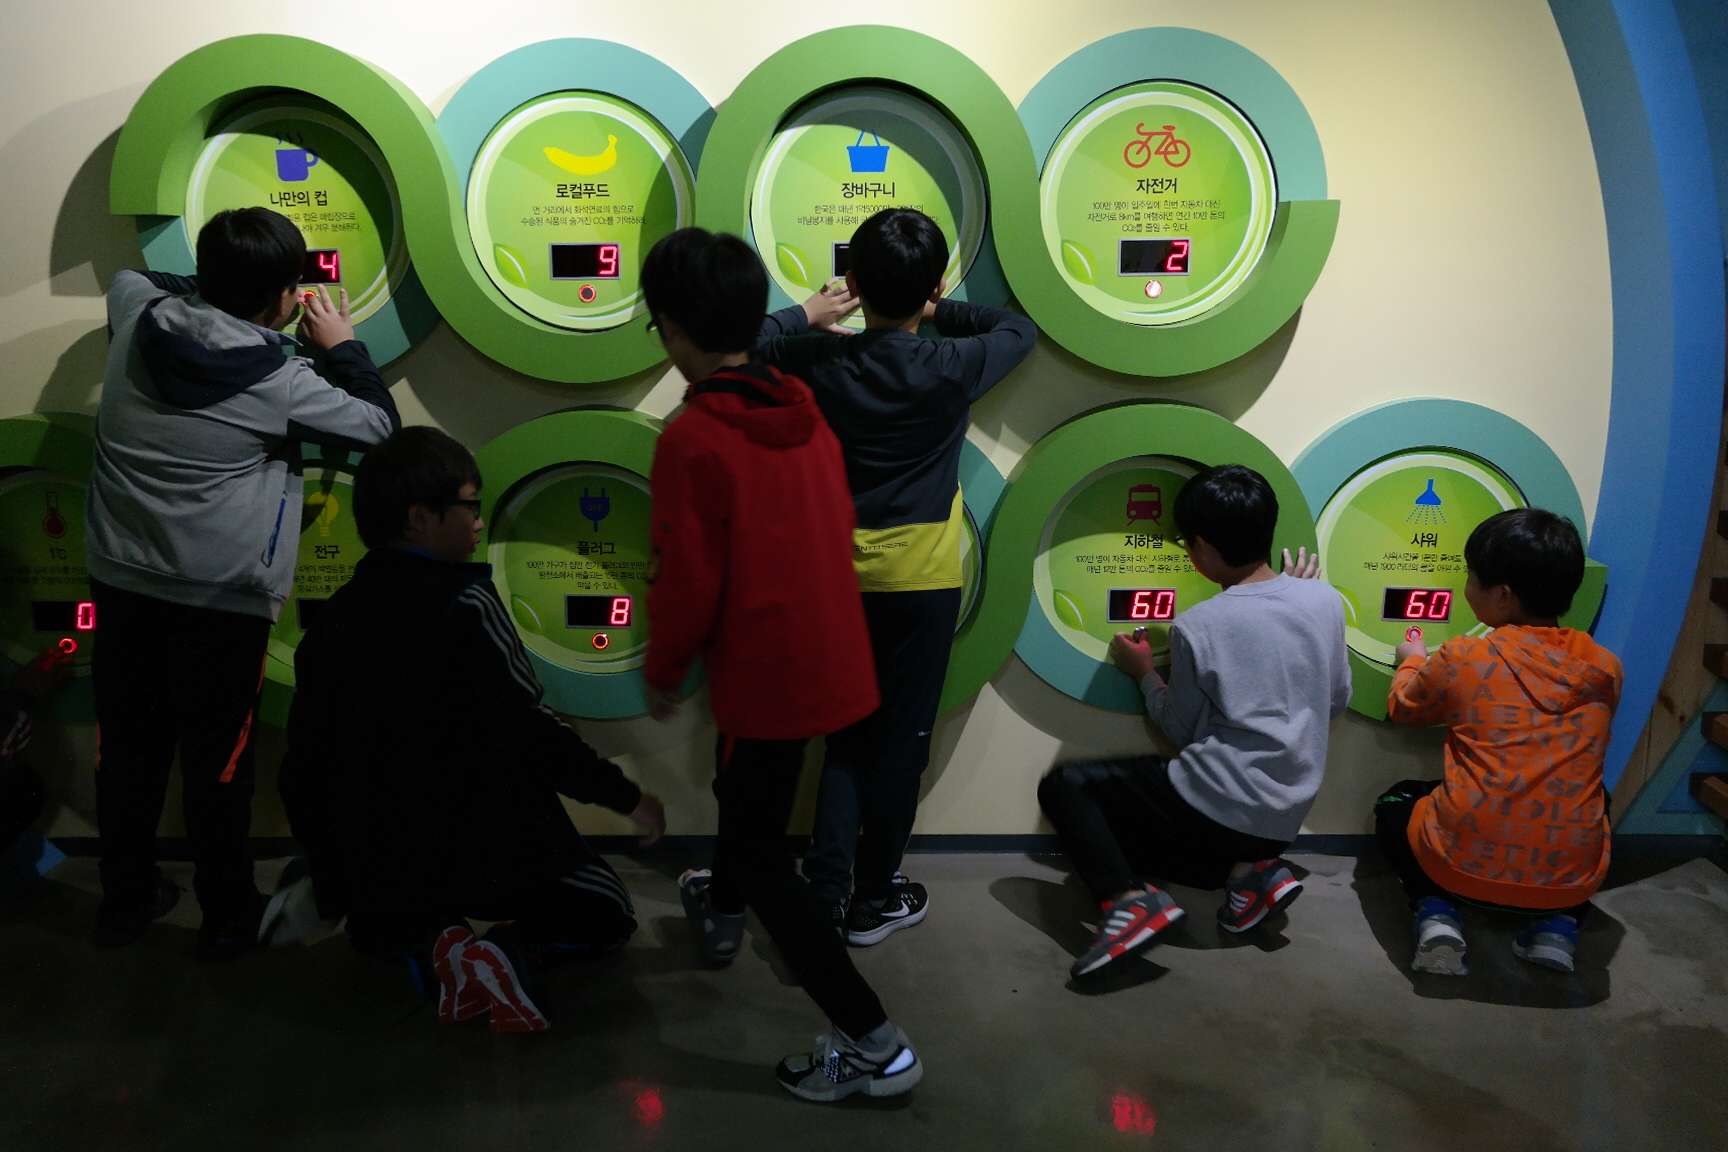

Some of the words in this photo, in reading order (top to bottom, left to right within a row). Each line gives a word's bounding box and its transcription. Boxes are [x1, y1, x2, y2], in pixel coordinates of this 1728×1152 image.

[556, 183, 610, 199] 로컬푸드
[841, 182, 895, 198] 장바구니
[1136, 178, 1177, 194] 자전거
[270, 191, 310, 207] 나만의
[314, 190, 328, 206] 컵
[543, 206, 572, 214] 거리에서
[814, 205, 836, 214] 한국은
[545, 217, 567, 226] 식품의
[836, 216, 859, 225] 사용해
[1162, 223, 1170, 232] 수
[598, 245, 618, 276] 9
[1165, 241, 1189, 271] 2
[319, 252, 339, 280] 4
[577, 541, 616, 555] 플러그
[1124, 534, 1164, 549] 지하철
[1411, 533, 1438, 548] 샤워
[314, 545, 340, 559] 전구
[1173, 565, 1181, 573] 수
[1453, 565, 1461, 573] 수
[594, 581, 601, 589] 수
[610, 597, 631, 625] 8
[1131, 591, 1174, 619] 60
[1406, 590, 1452, 619] 60
[76, 602, 96, 630] 0
